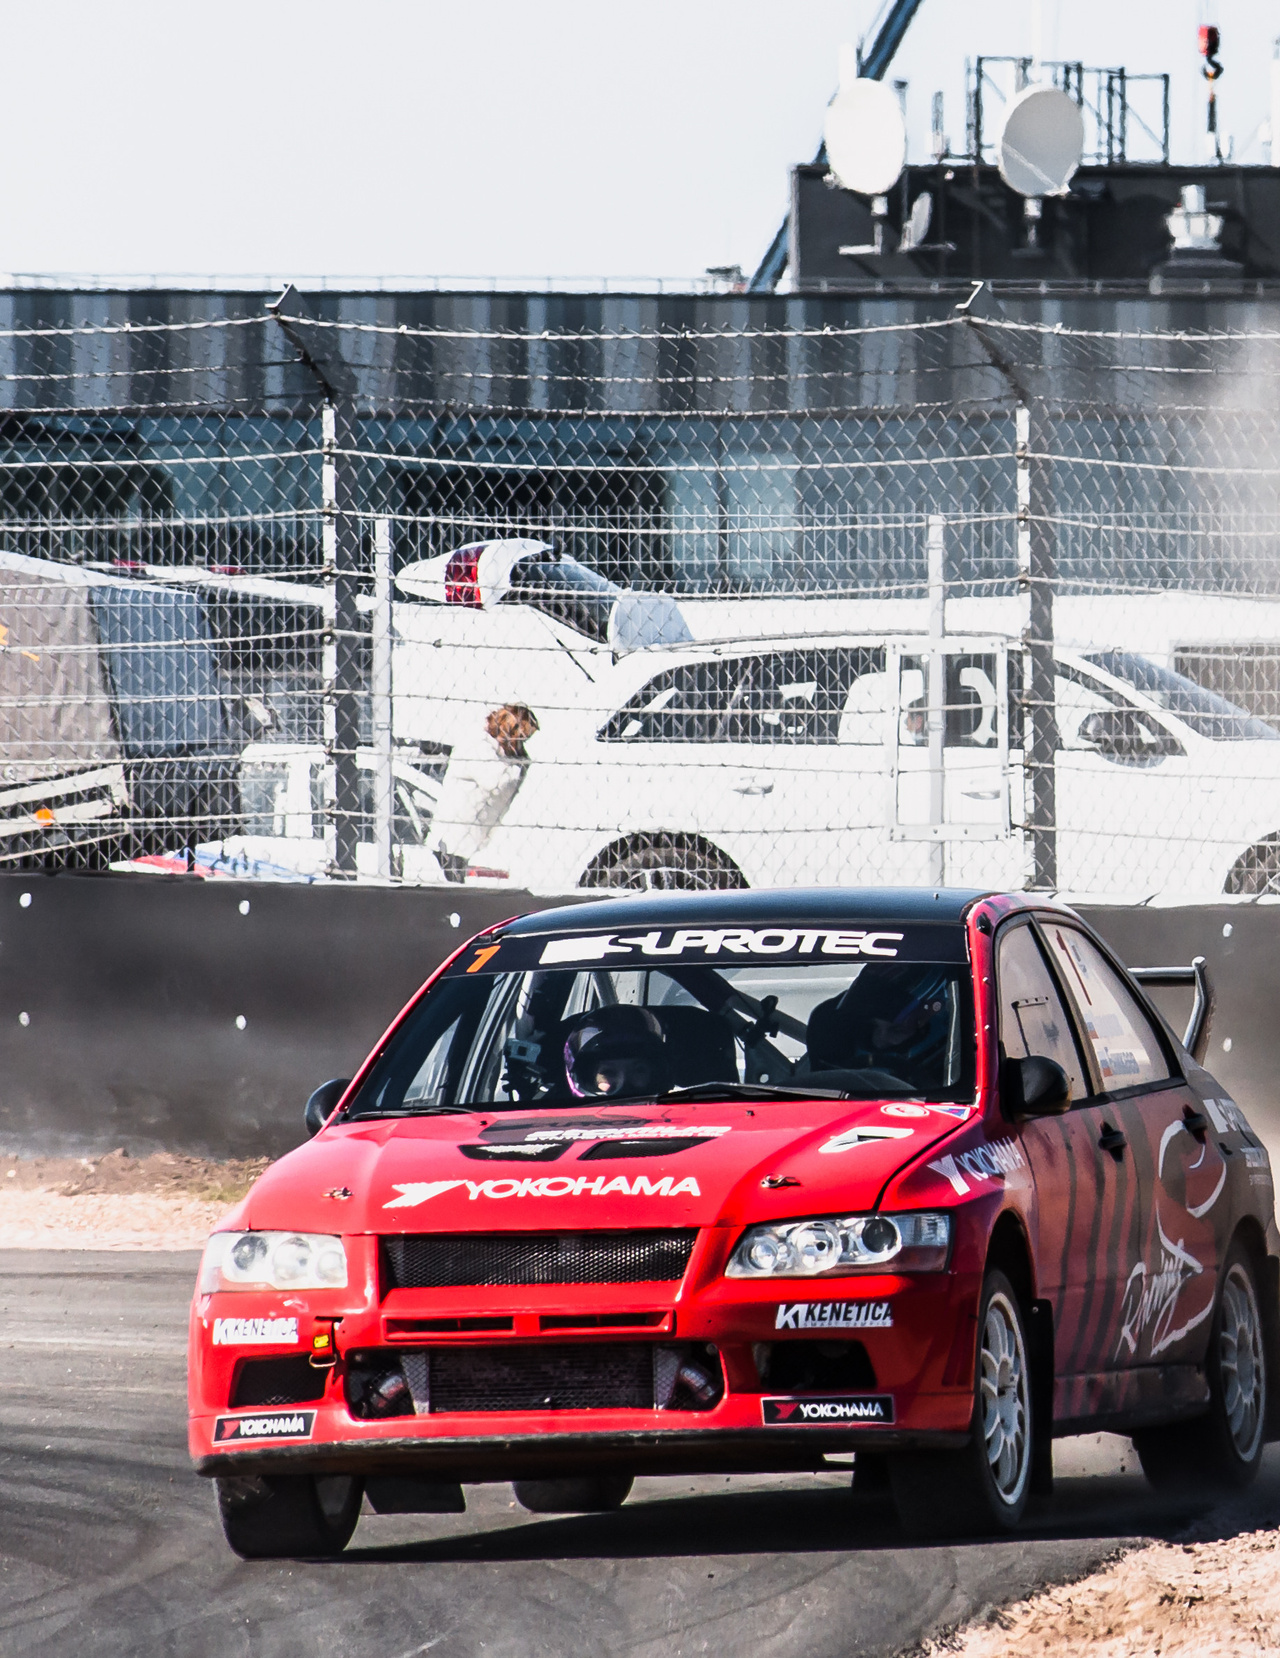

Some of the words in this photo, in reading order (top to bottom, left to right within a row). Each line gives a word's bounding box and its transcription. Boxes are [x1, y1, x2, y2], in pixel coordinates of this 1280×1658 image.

[602, 928, 904, 957] SUPROTEC
[466, 945, 501, 973] 1
[954, 1136, 1026, 1182] YOKOHAMA
[466, 1175, 701, 1200] YOKOHAMA
[804, 1302, 892, 1321] KENETICA
[799, 1401, 884, 1418] YOKOHAMA
[239, 1416, 305, 1436] YOKOHAMA
